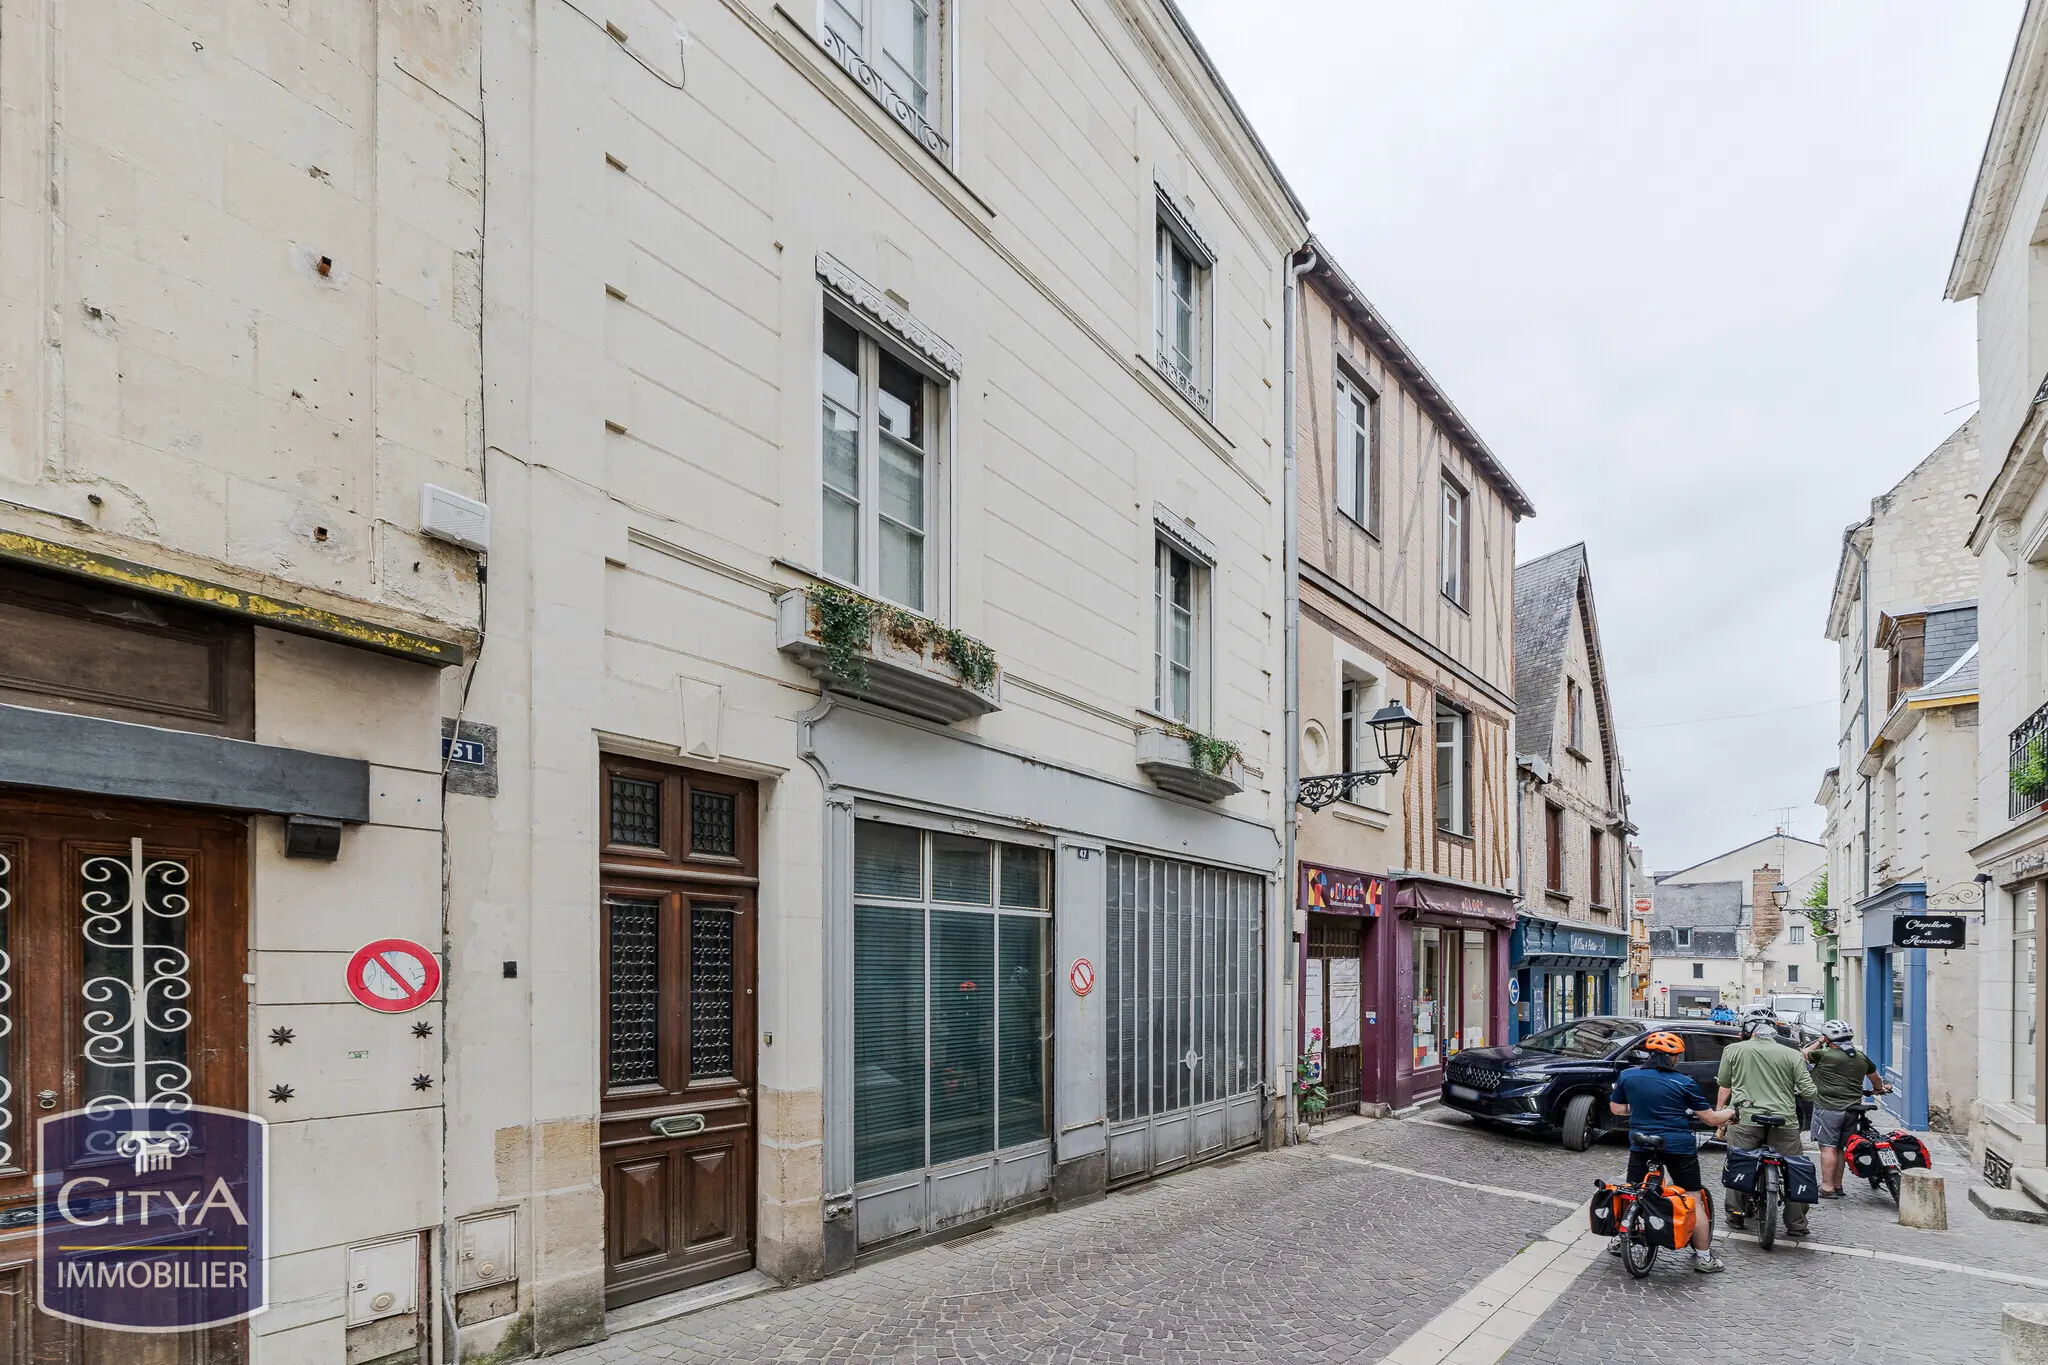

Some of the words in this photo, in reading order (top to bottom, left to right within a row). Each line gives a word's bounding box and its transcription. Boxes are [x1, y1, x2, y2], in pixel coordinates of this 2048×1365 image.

[453, 742, 473, 760] 51
[1079, 849, 1087, 858] 47
[1905, 919, 1952, 930] Chapellerie
[1902, 934, 1954, 946] Accessoires
